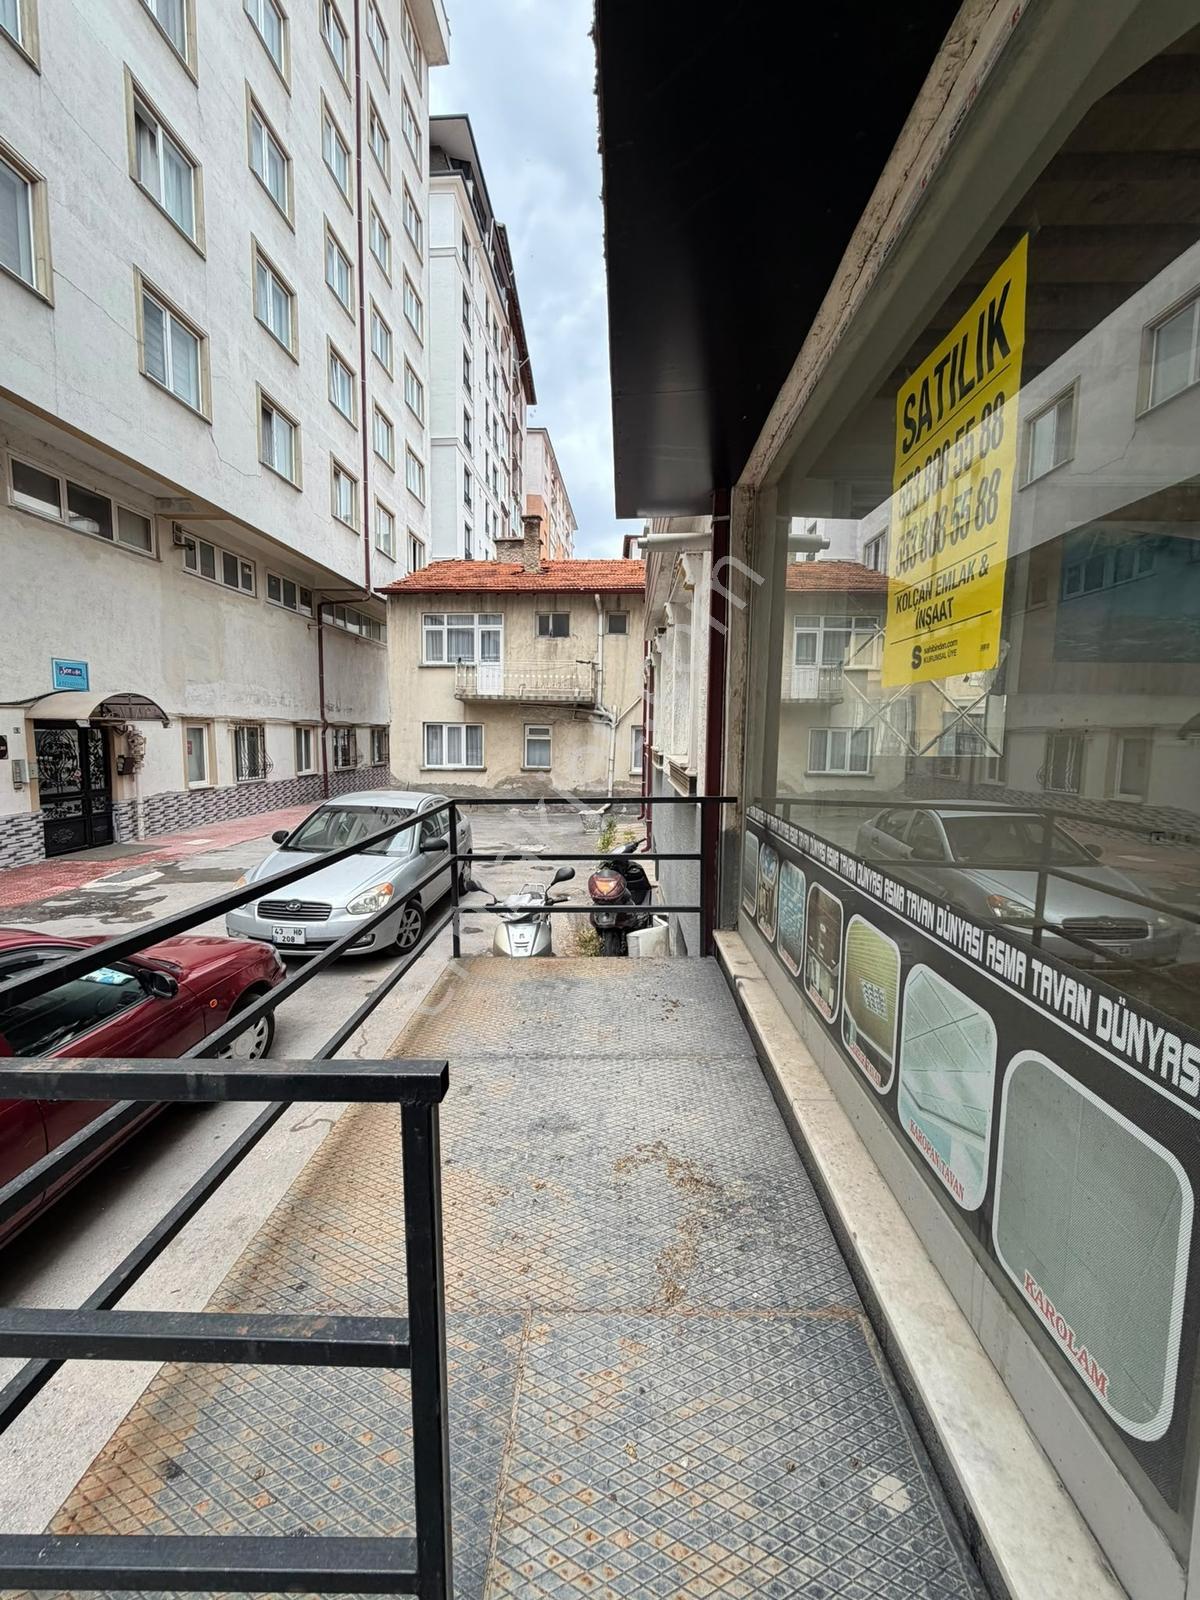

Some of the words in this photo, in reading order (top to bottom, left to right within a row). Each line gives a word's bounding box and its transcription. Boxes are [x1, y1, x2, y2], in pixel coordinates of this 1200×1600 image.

[902, 279, 1011, 454] SATILIK
[979, 391, 1005, 459] 88
[950, 487, 974, 546] 55
[974, 468, 1002, 532] 88
[915, 598, 954, 632] İNŞAAT
[935, 558, 976, 598] EMLAK
[978, 554, 990, 577] &
[857, 860, 884, 899] DÜNYASI
[884, 877, 905, 913] ASMA
[906, 889, 935, 931] TAVAN
[936, 904, 984, 961] DÜNYASI
[986, 935, 1027, 989] ASMA
[1031, 957, 1092, 1030] TAVAN
[1023, 1269, 1109, 1398] KAROLAM
